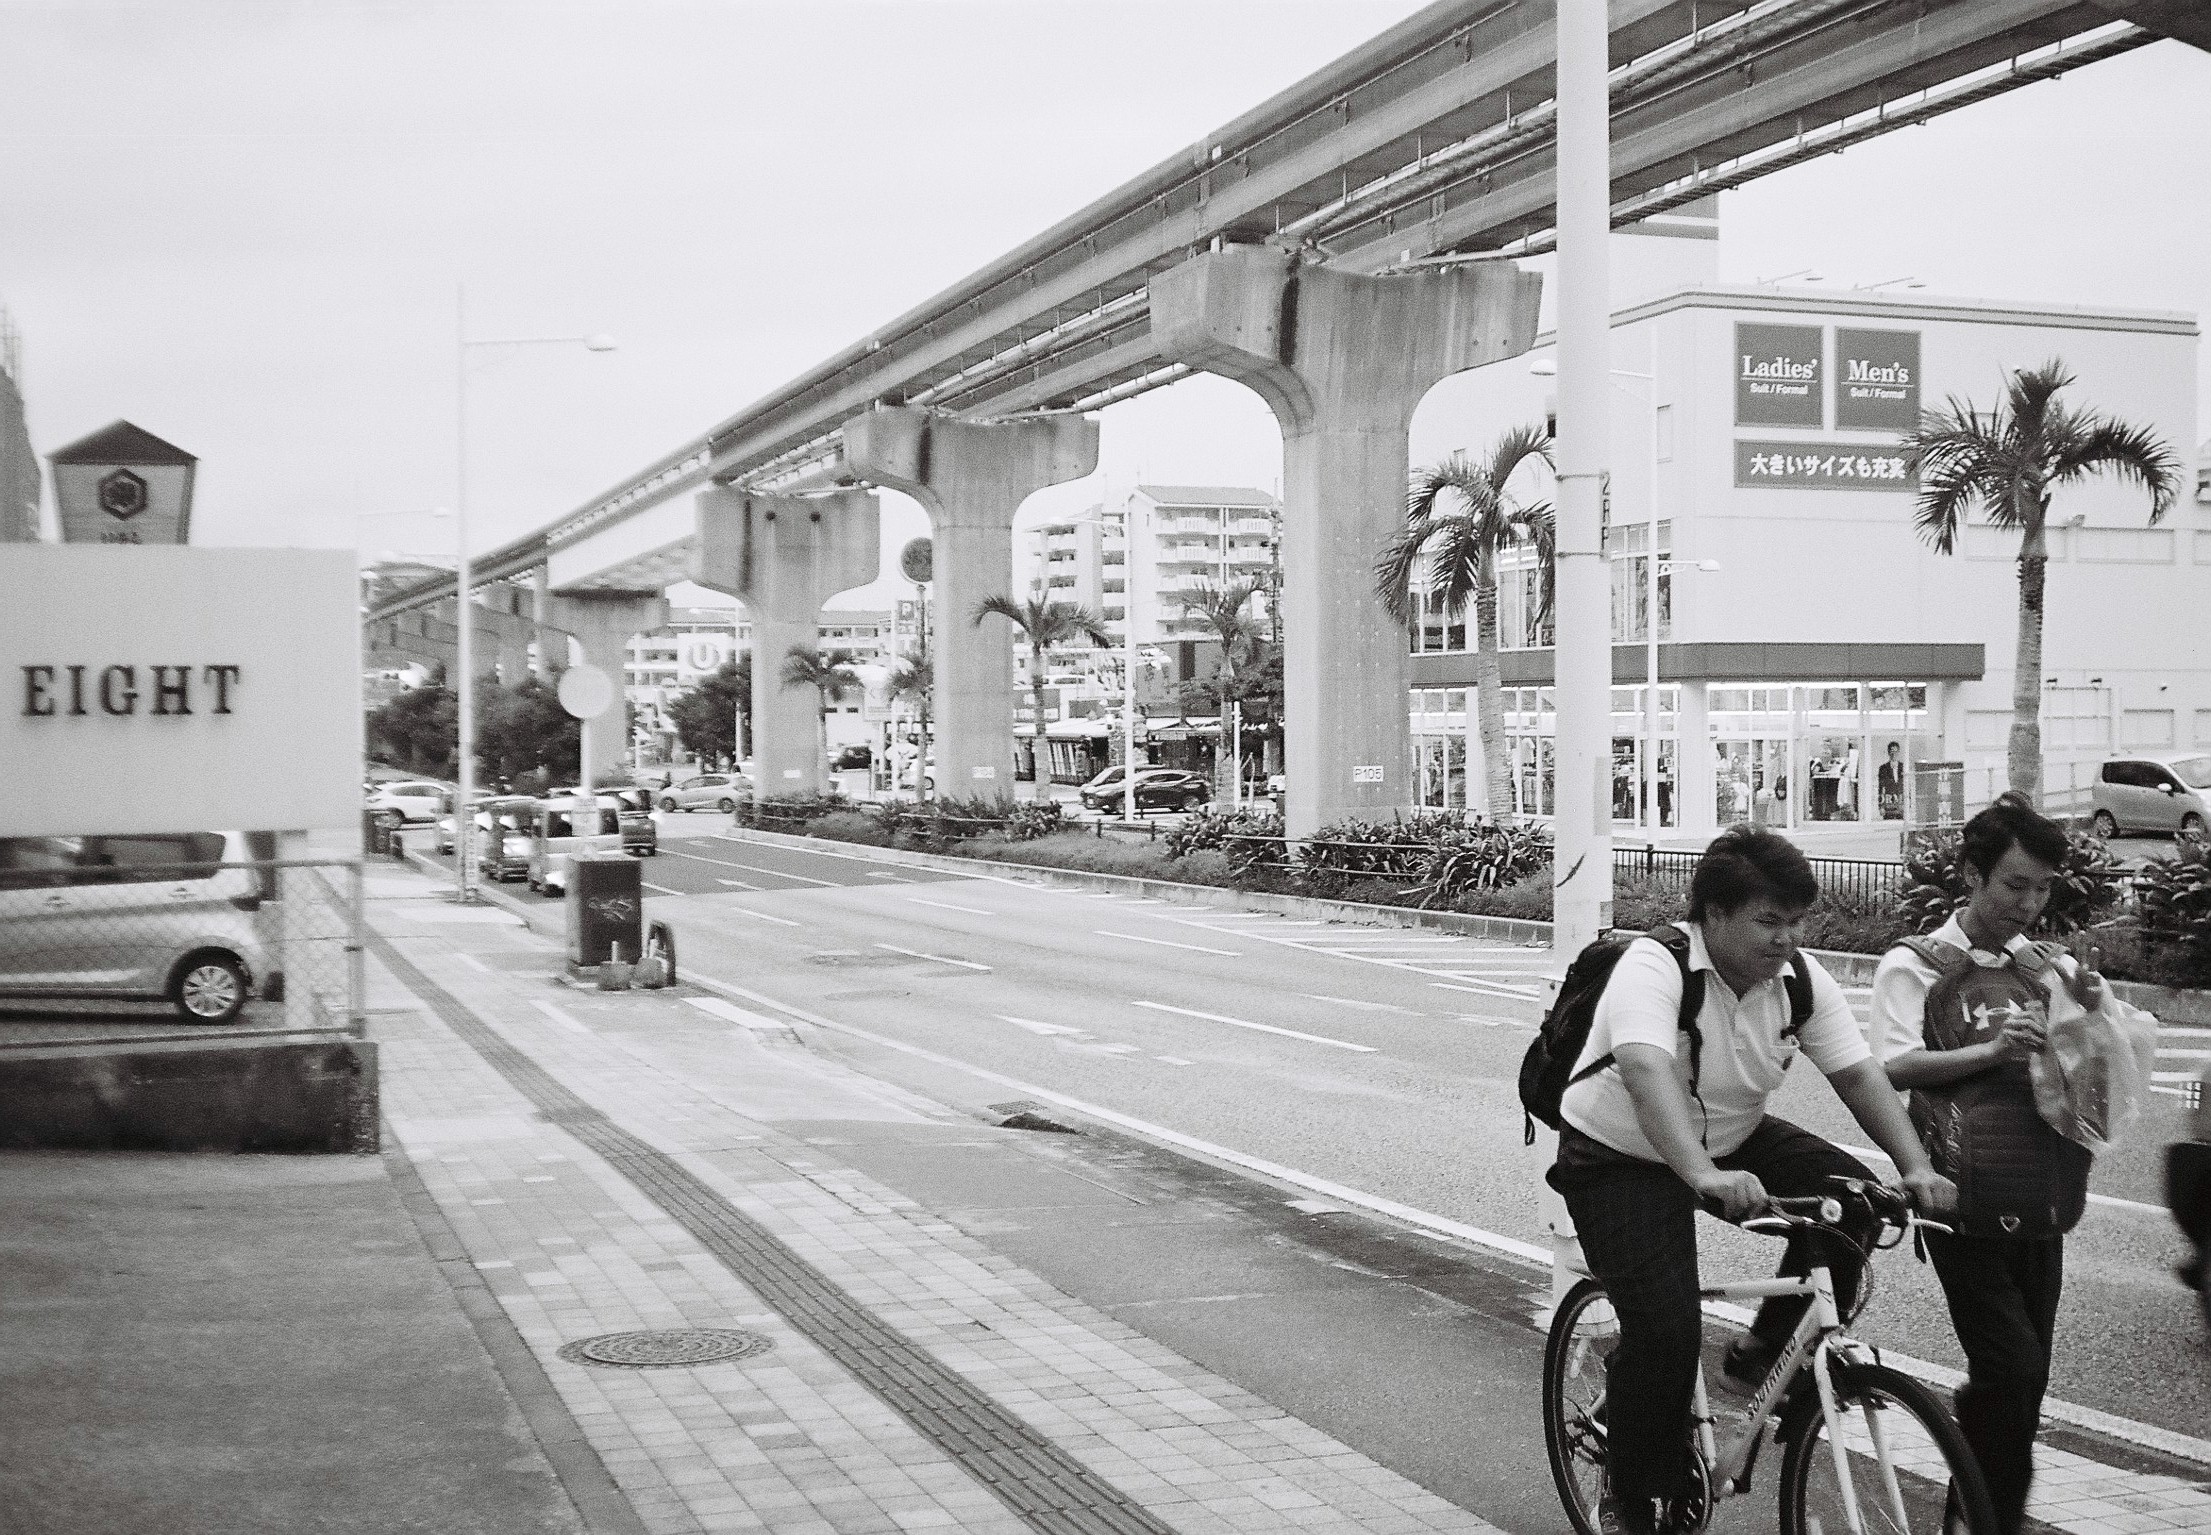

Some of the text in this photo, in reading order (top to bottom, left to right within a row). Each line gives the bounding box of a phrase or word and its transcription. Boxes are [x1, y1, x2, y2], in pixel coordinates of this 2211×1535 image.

[1742, 355, 1818, 379] Ladies'
[1847, 359, 1910, 383] Men's
[20, 664, 241, 718] EIGHT
[1354, 768, 1382, 780] P105
